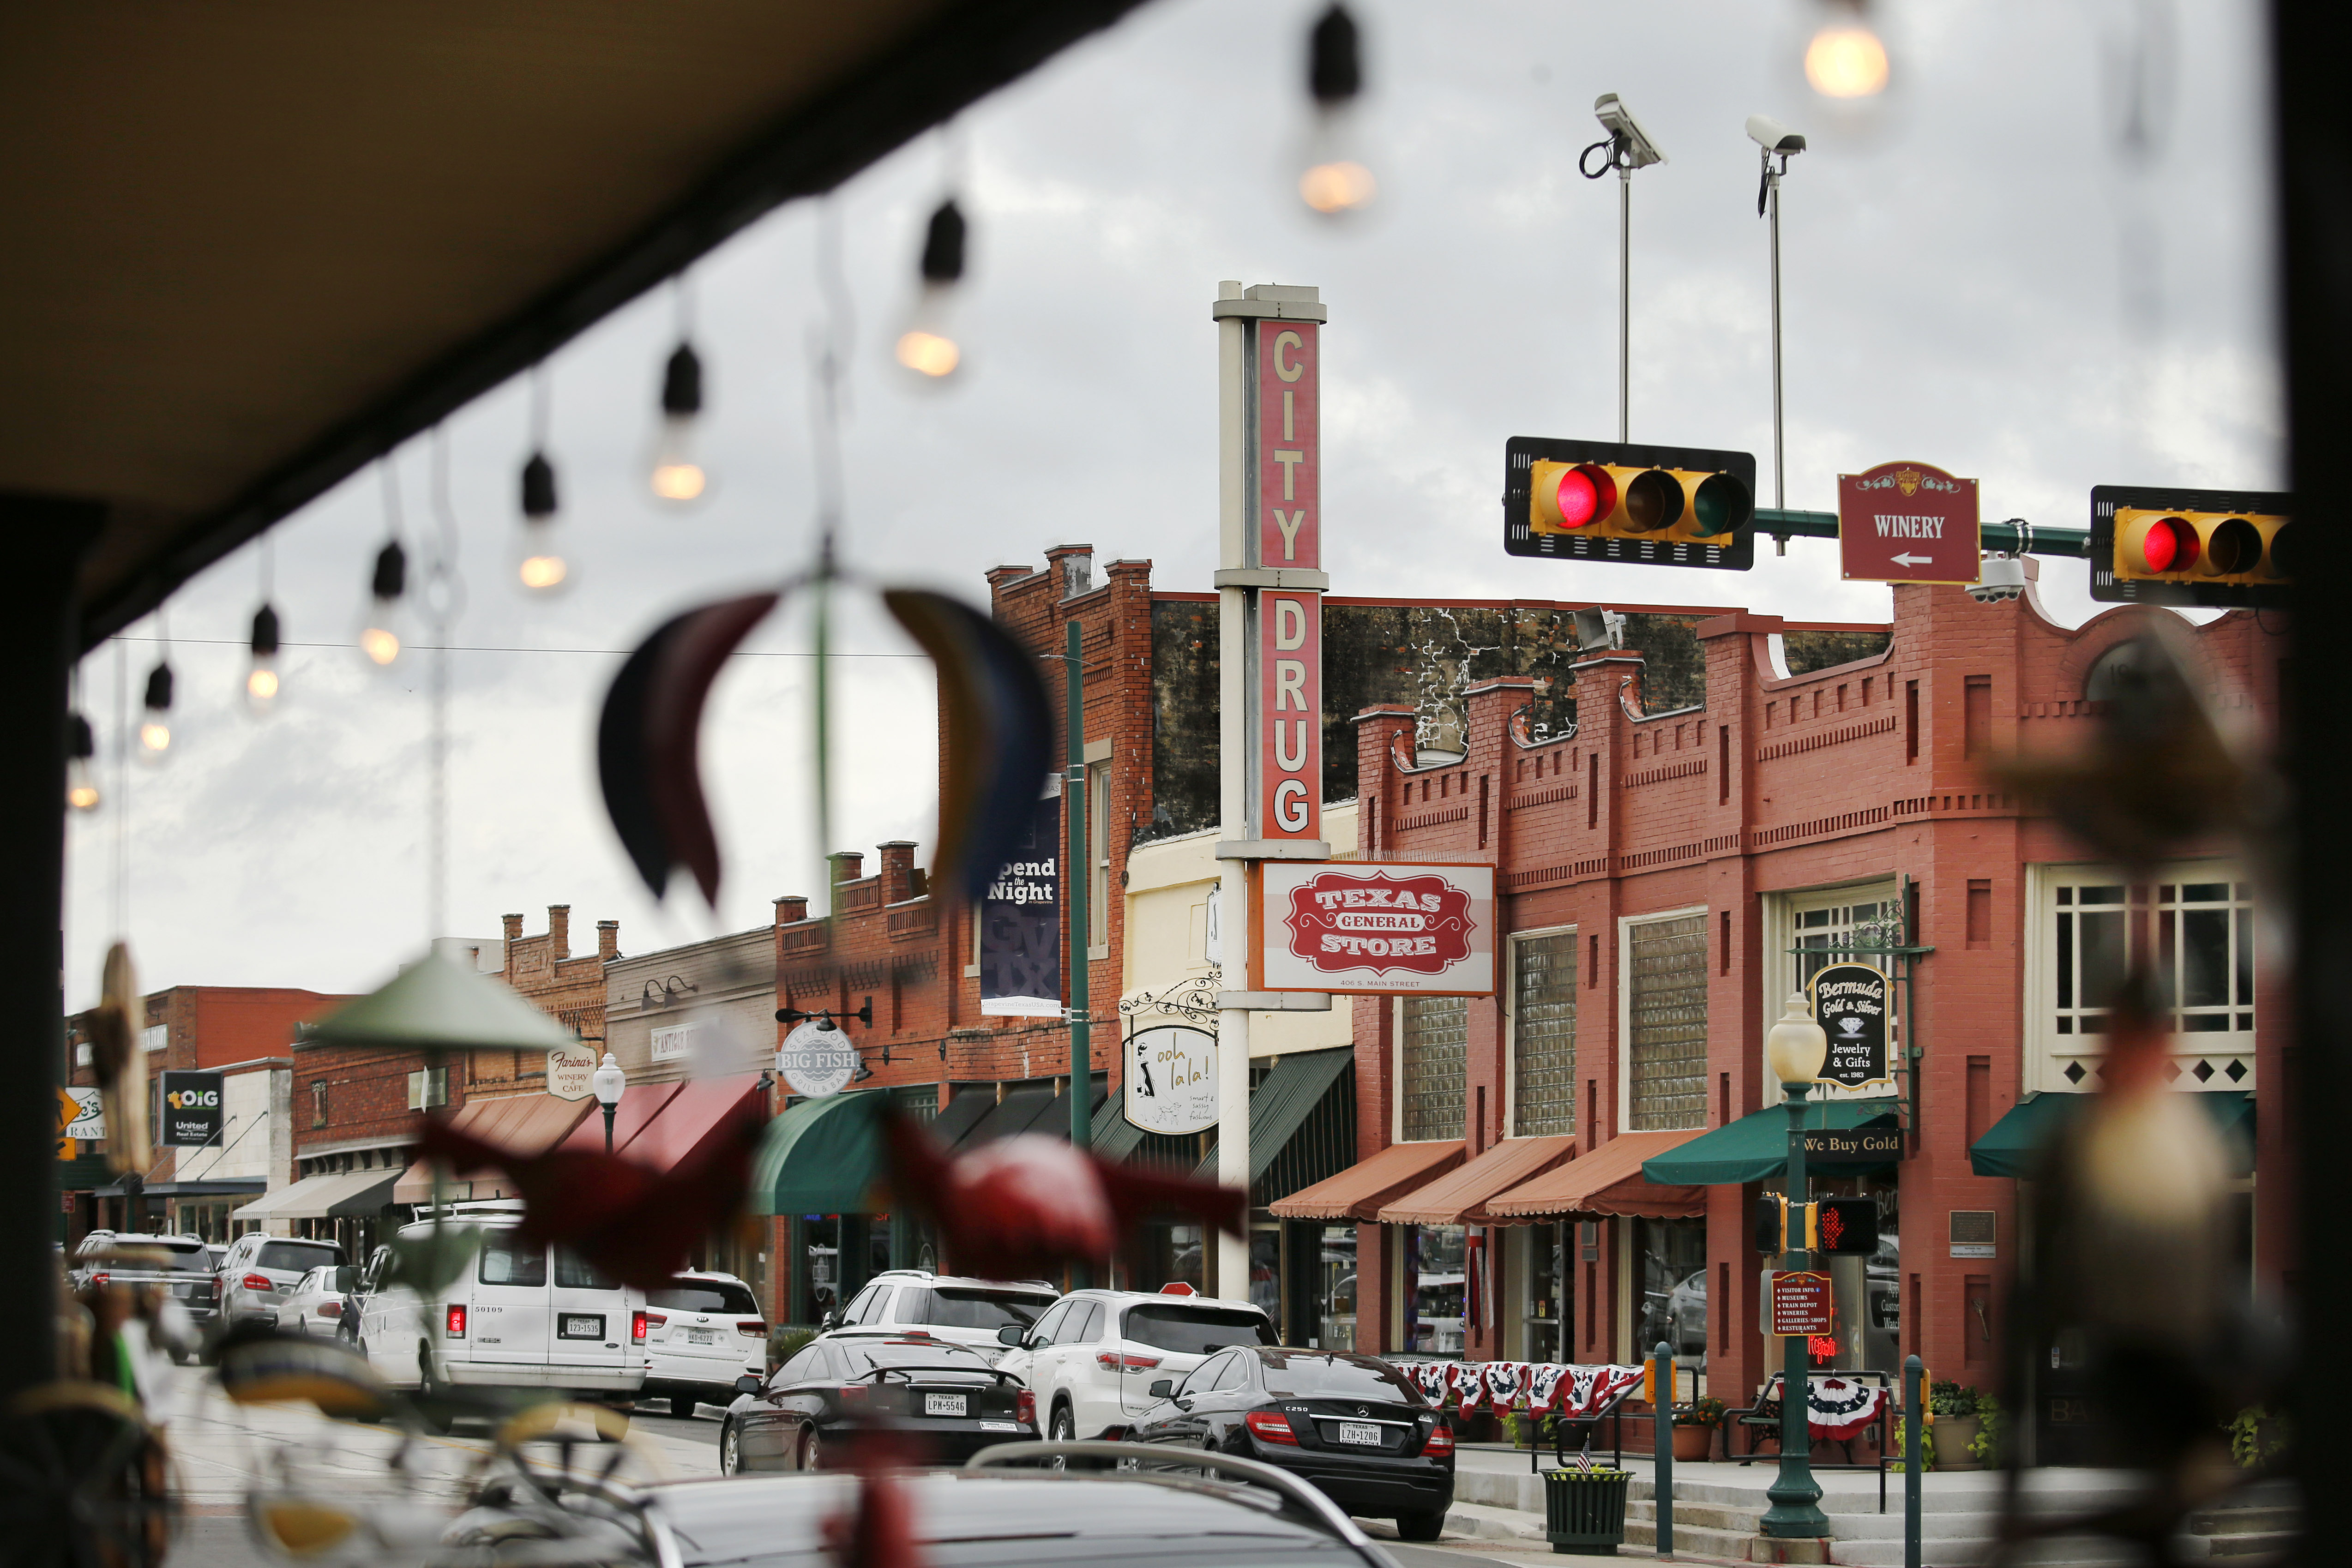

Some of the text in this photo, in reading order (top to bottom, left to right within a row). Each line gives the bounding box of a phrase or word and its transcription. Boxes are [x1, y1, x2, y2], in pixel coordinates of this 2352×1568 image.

[1272, 330, 1305, 560] CITY
[1873, 515, 1945, 539] WINERY
[1273, 598, 1309, 832] DRUG
[998, 858, 1056, 880] pend
[1014, 877, 1024, 886] the
[987, 882, 1053, 905] Night
[1315, 889, 1441, 912] TEXAS
[1341, 915, 1420, 928] GENERAL
[1320, 934, 1436, 956] STORE
[1818, 980, 1883, 999] Bermuda
[983, 1001, 1060, 1009] GrapevineTexasUSA.com
[1823, 999, 1882, 1018] Gold & Silver
[789, 1027, 846, 1050] SEAFOOD
[1158, 1032, 1185, 1063] ooh
[1832, 1044, 1871, 1057] Jewelry
[552, 1051, 594, 1072] Farina's
[781, 1053, 856, 1068] BIG FISH
[1833, 1057, 1871, 1068] & Gifts
[558, 1074, 589, 1082] WINERY
[791, 1072, 817, 1093] GRILL
[831, 1071, 847, 1088] BAR
[1190, 1093, 1208, 1102] smart
[1189, 1111, 1212, 1121] fashions
[1192, 1103, 1209, 1113] sassy
[1805, 1137, 1898, 1153] We Buy Gold
